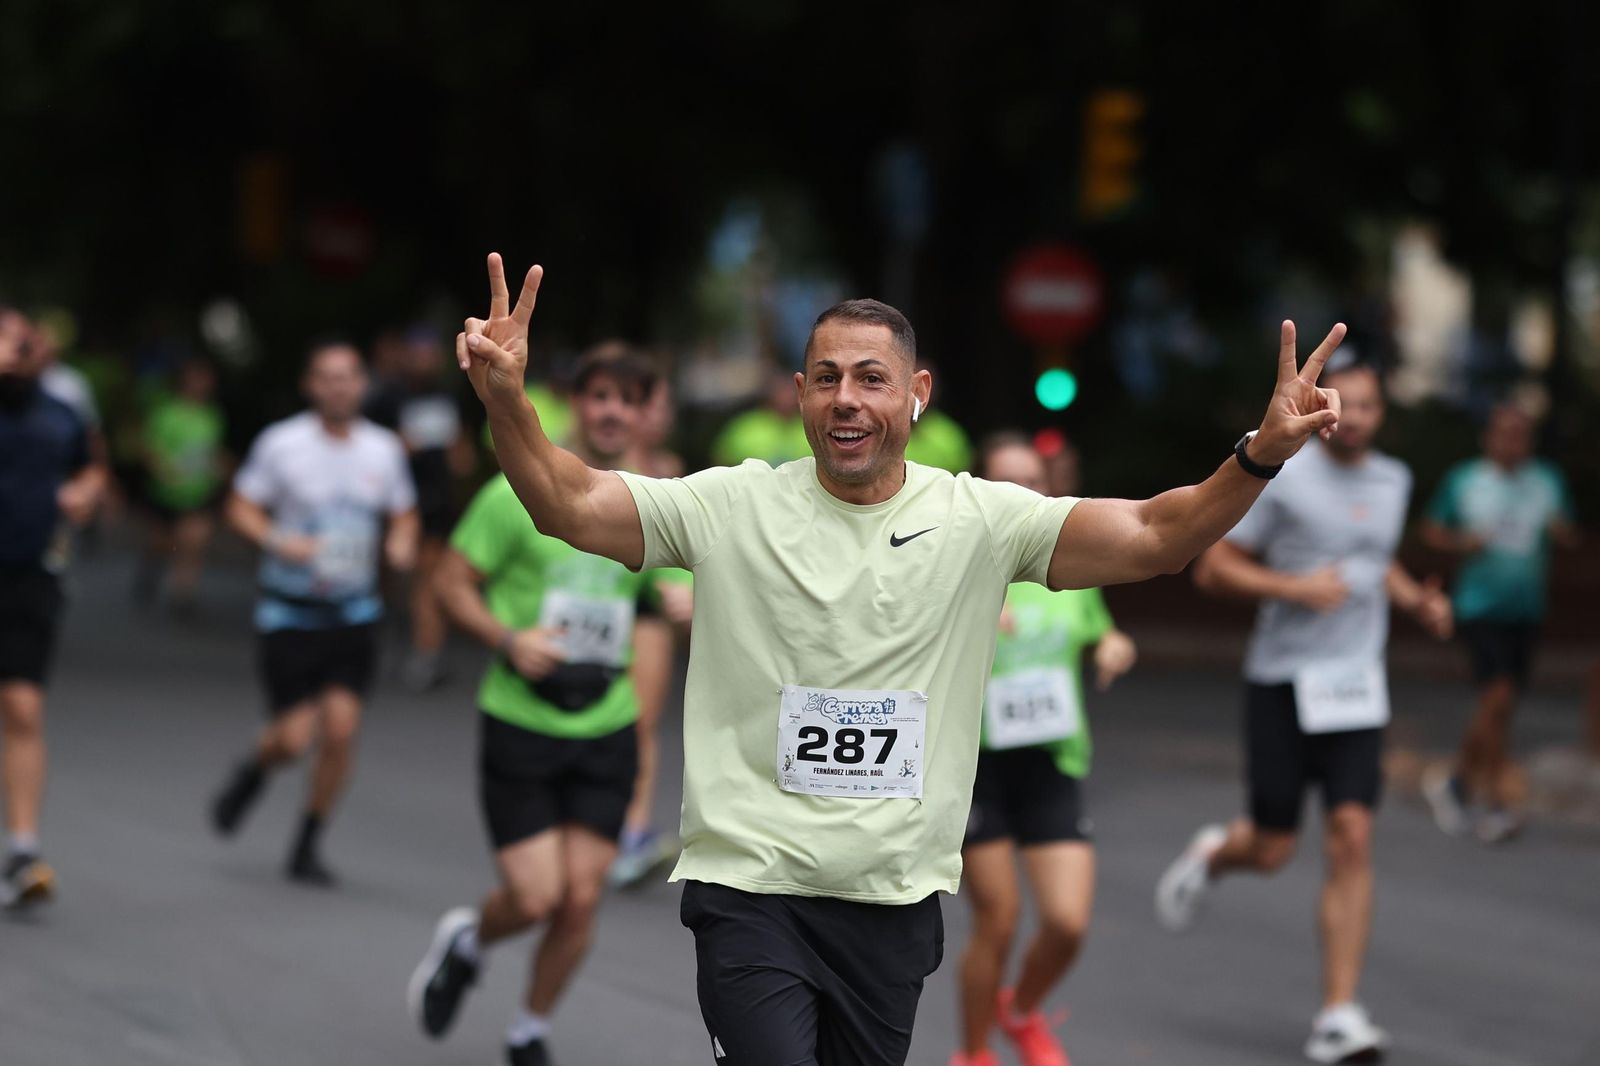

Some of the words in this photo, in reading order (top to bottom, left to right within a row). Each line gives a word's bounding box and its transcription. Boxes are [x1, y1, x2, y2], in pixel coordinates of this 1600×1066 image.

[821, 697, 883, 714] Carrera
[836, 713, 888, 724] Prensa
[797, 726, 898, 764] 287
[813, 767, 844, 776] FERNÁNDEZ
[845, 769, 869, 777] LINARES,
[870, 767, 884, 776] RAÚL
